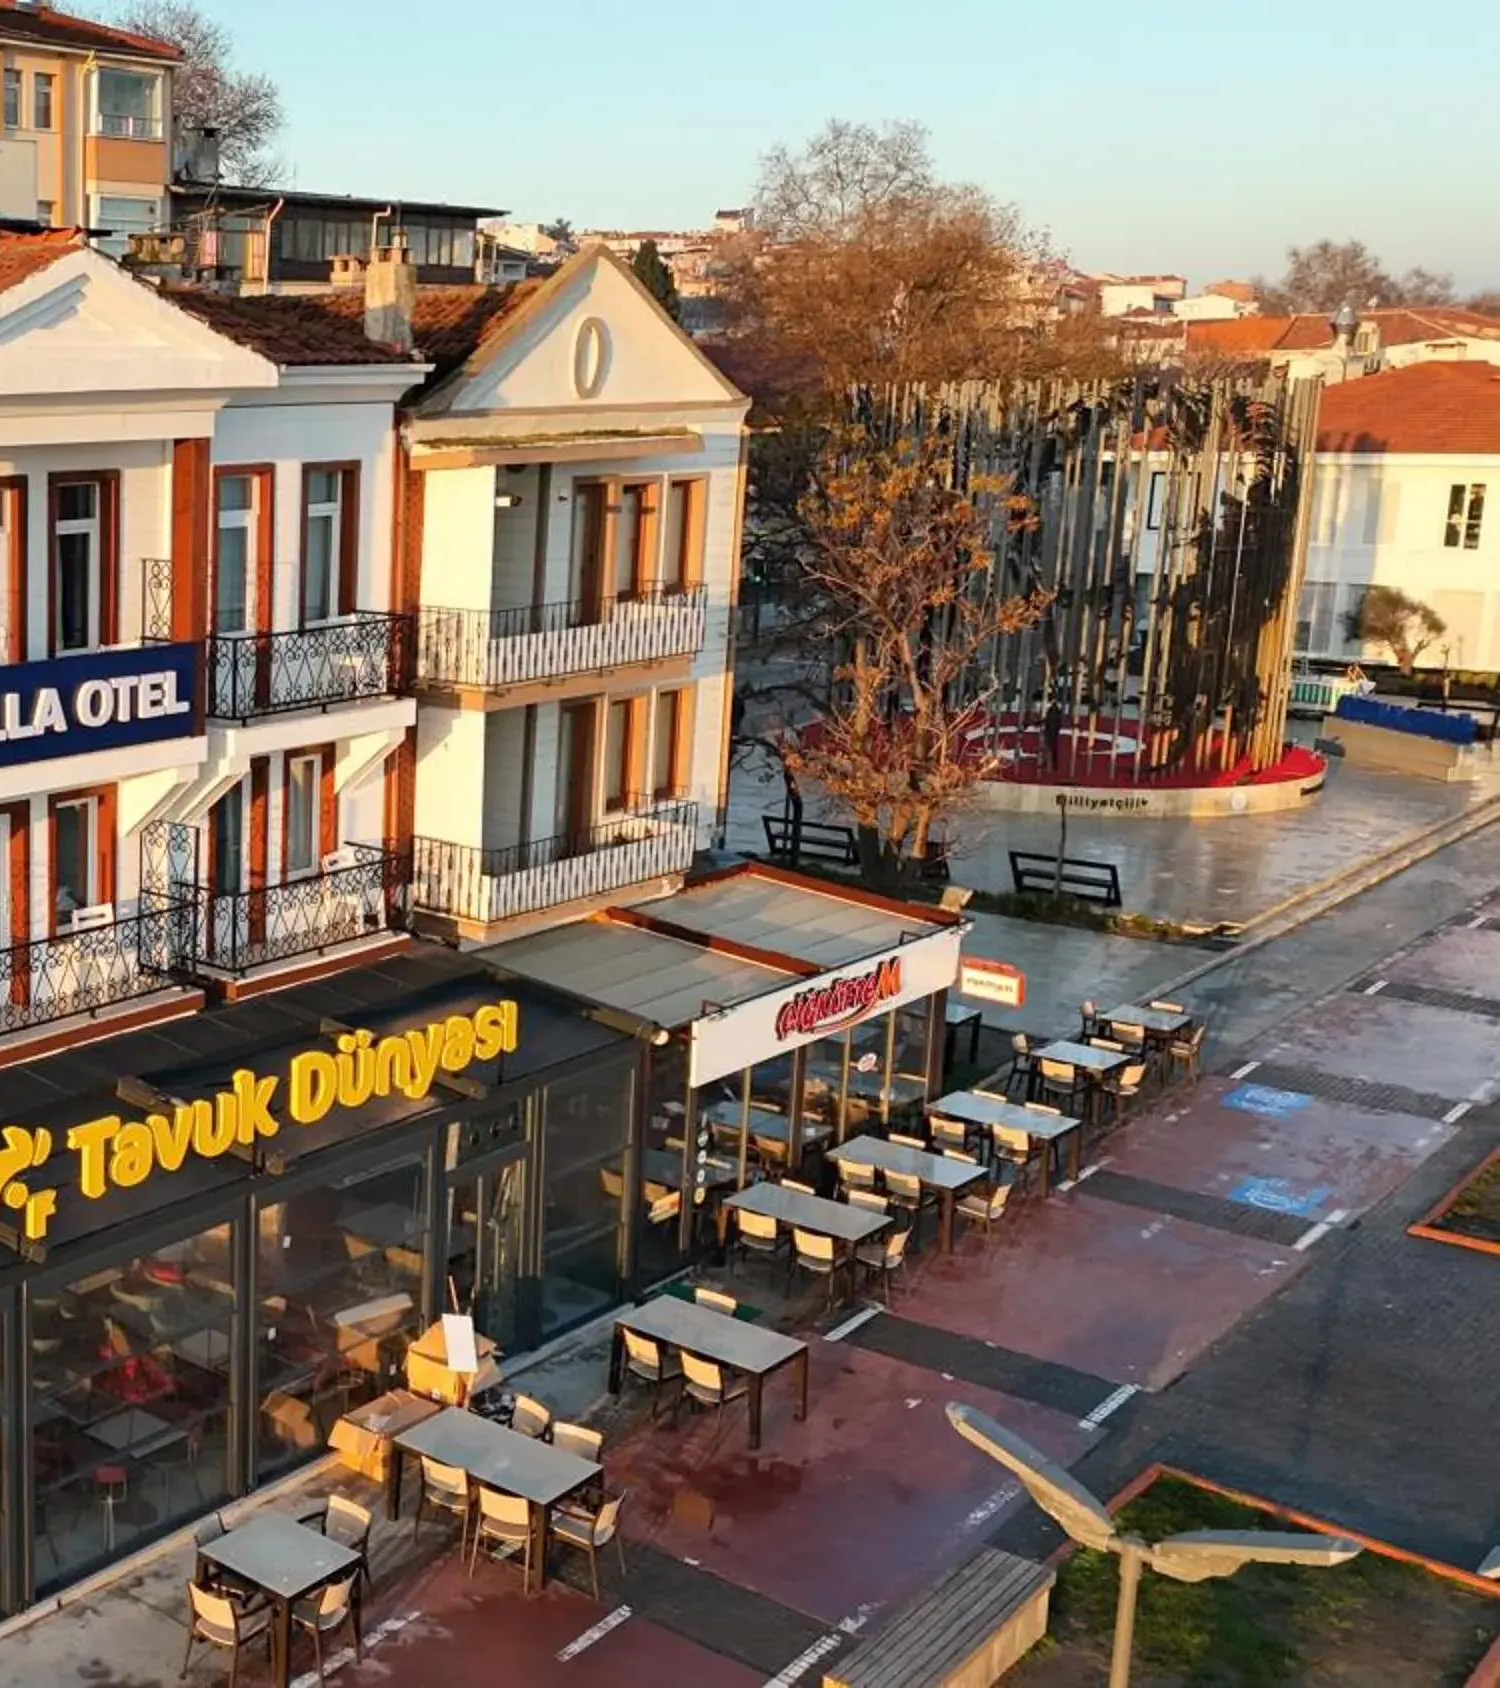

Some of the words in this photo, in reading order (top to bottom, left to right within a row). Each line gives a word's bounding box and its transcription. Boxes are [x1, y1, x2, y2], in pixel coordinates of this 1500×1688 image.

[76, 670, 190, 728] OTEL
[67, 1067, 280, 1199] Tavuk
[290, 999, 519, 1125] Dünyası
